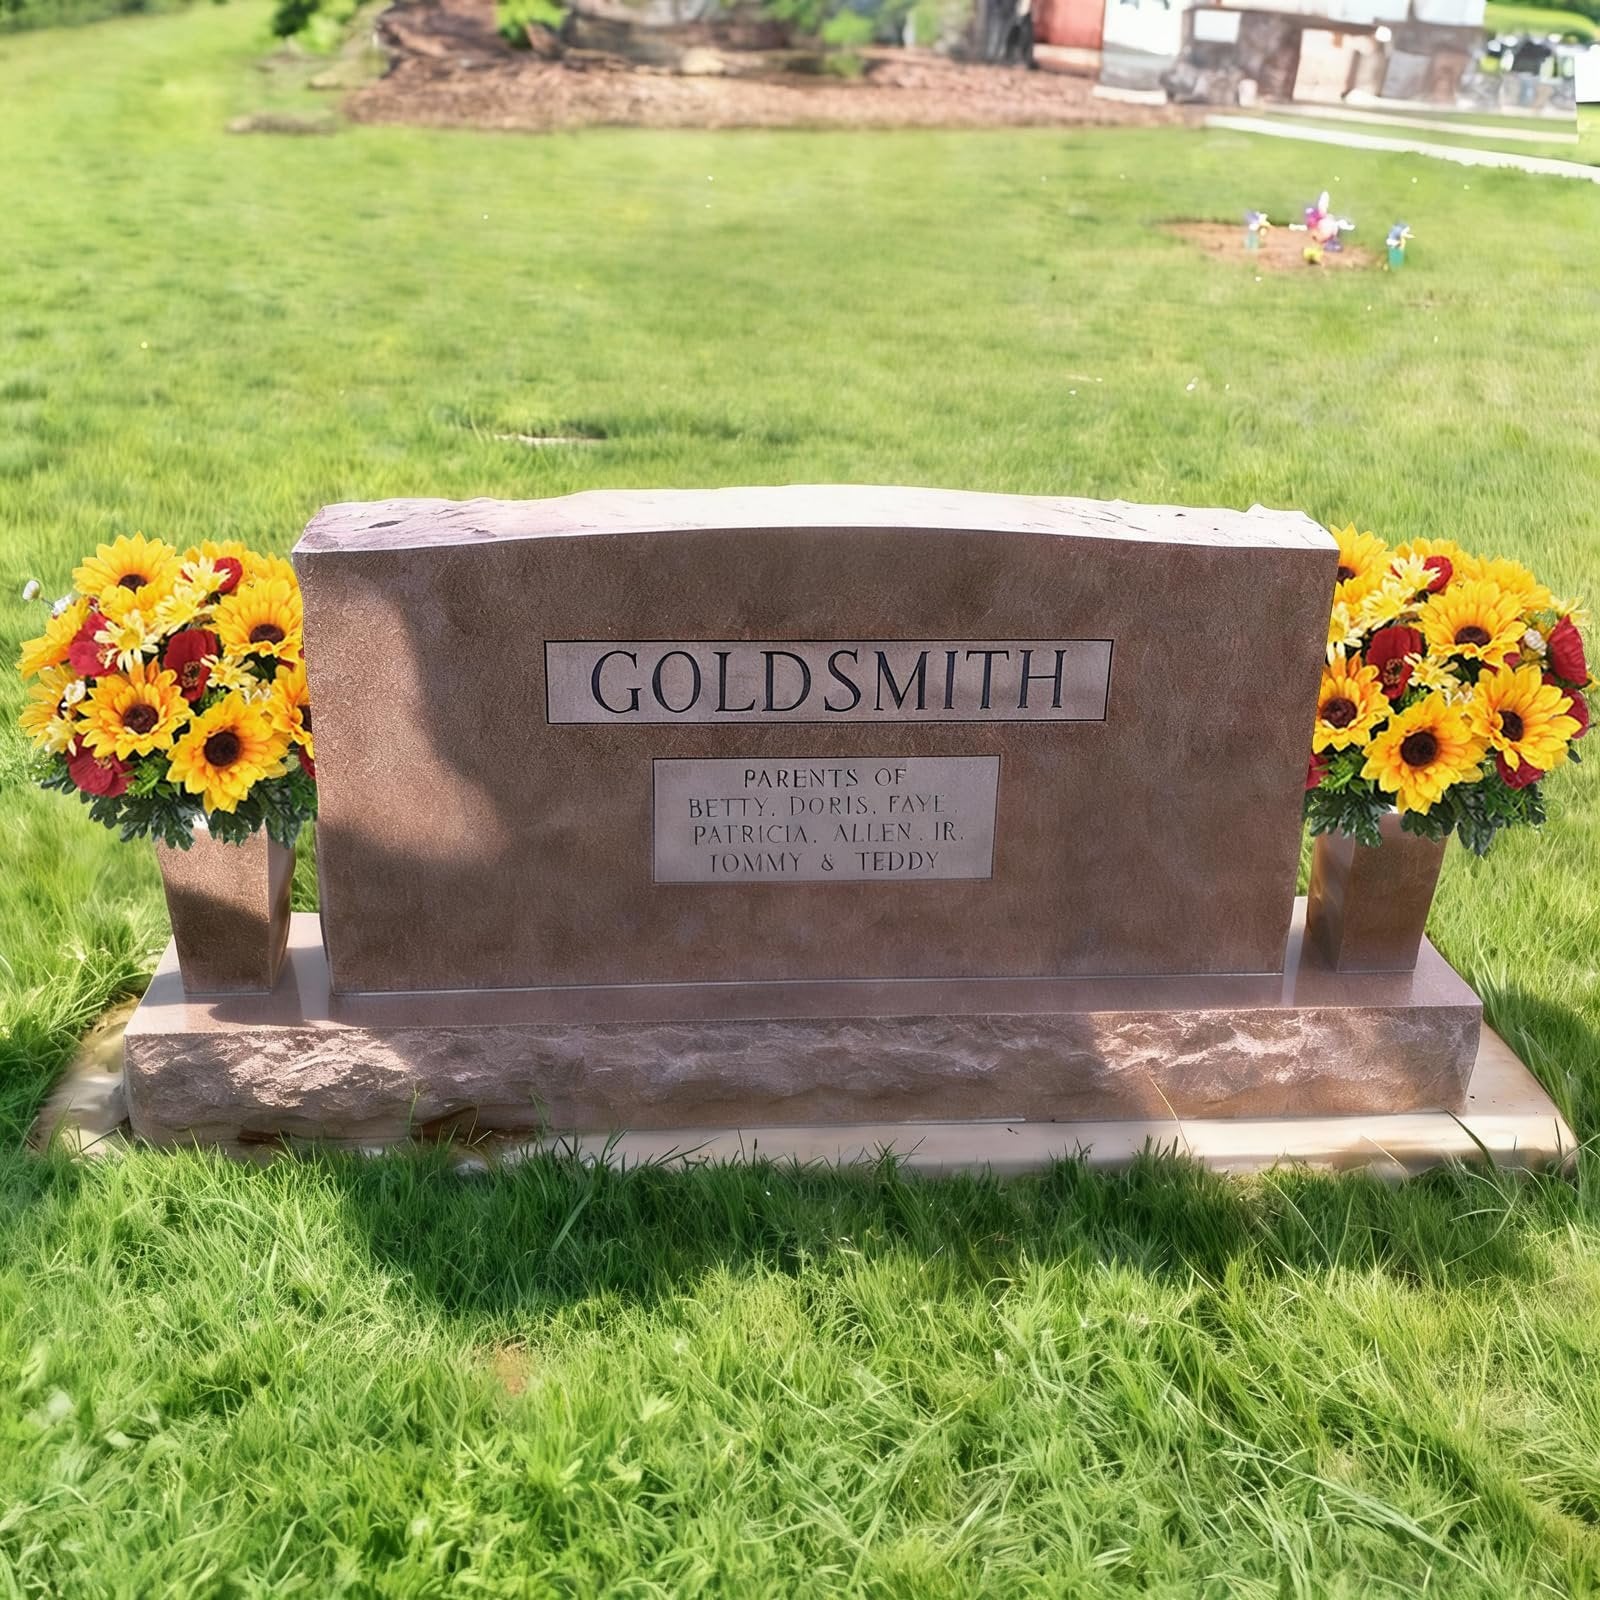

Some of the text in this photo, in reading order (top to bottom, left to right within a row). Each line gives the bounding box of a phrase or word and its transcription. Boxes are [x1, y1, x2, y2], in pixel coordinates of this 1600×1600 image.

[591, 650, 1067, 712] GOLDSMITH
[744, 767, 906, 789] PARENTS OF
[710, 851, 940, 873] TOMMY & TEDDY
